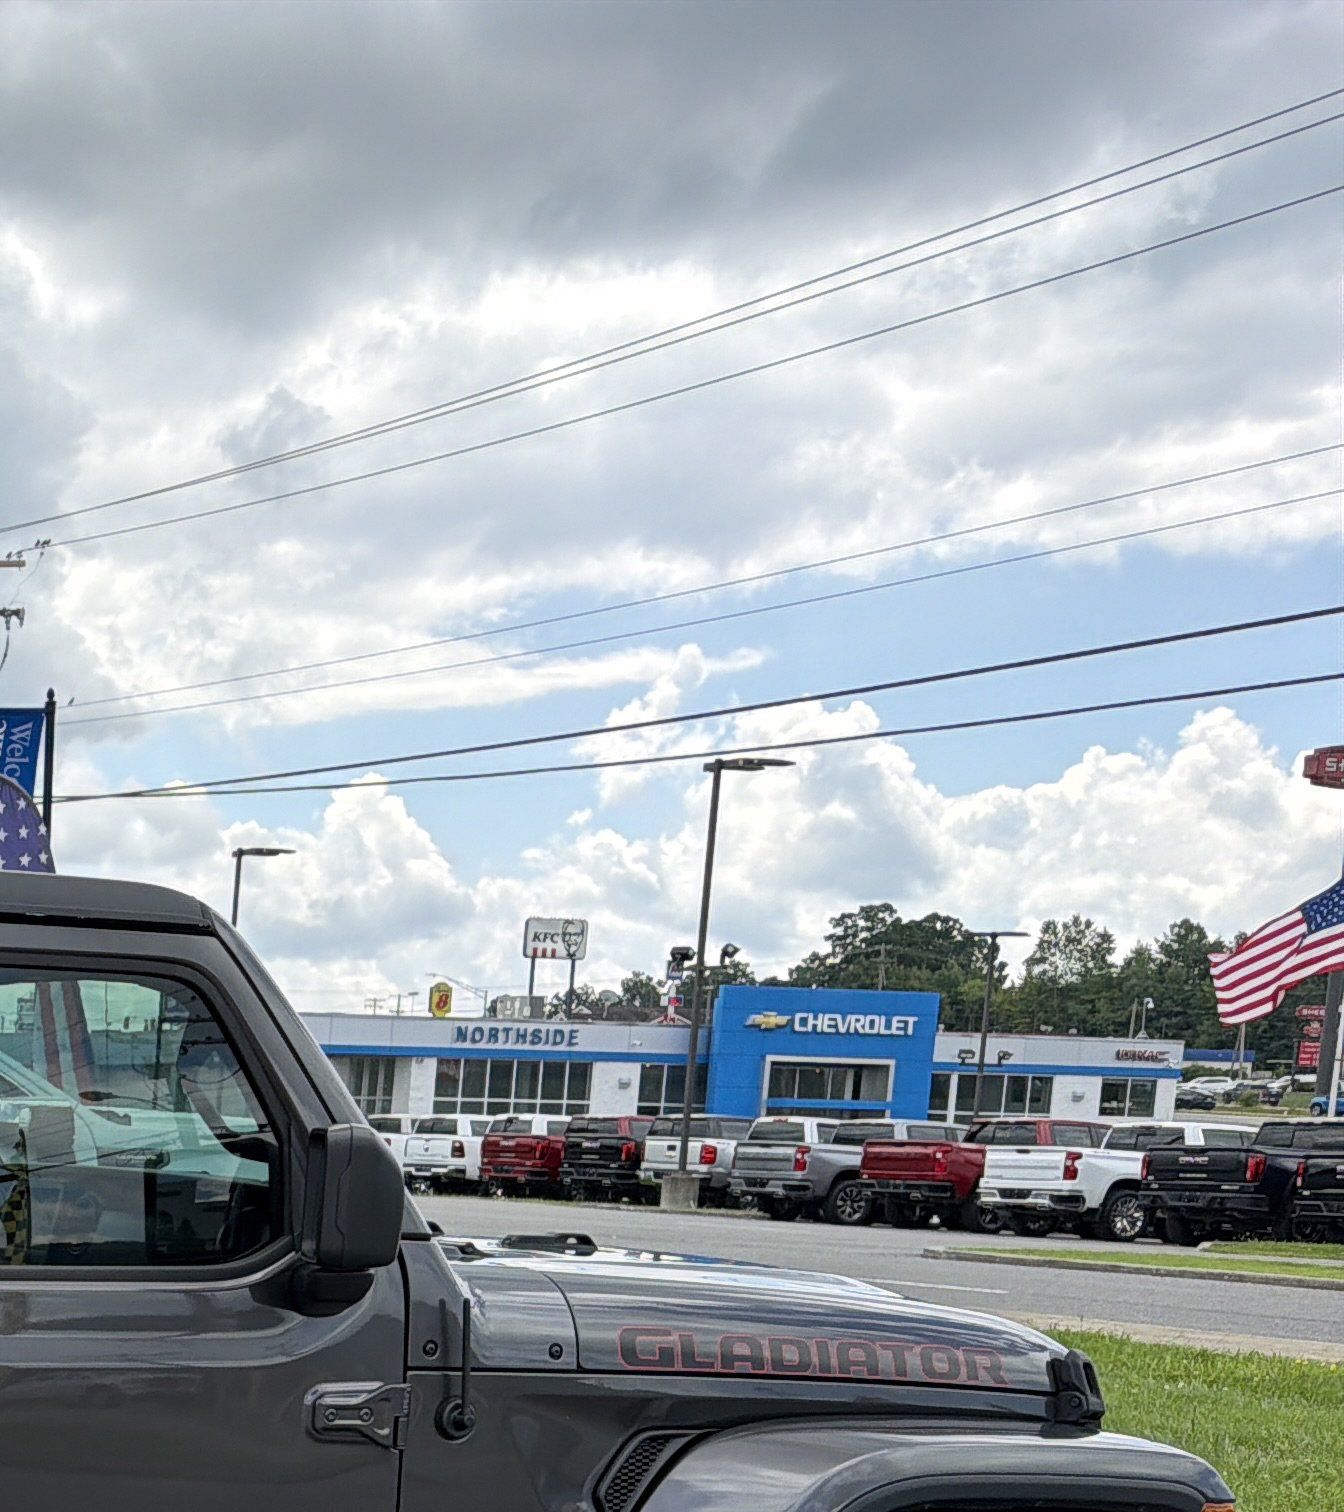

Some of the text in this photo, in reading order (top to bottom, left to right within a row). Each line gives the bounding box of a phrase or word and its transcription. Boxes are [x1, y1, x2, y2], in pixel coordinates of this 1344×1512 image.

[3, 720, 34, 781] Welc
[531, 931, 561, 944] KFC
[455, 1025, 580, 1047] NORTHSIDE
[793, 1012, 919, 1036] CHEVROLET
[617, 1325, 1010, 1386] GLADIATOR
